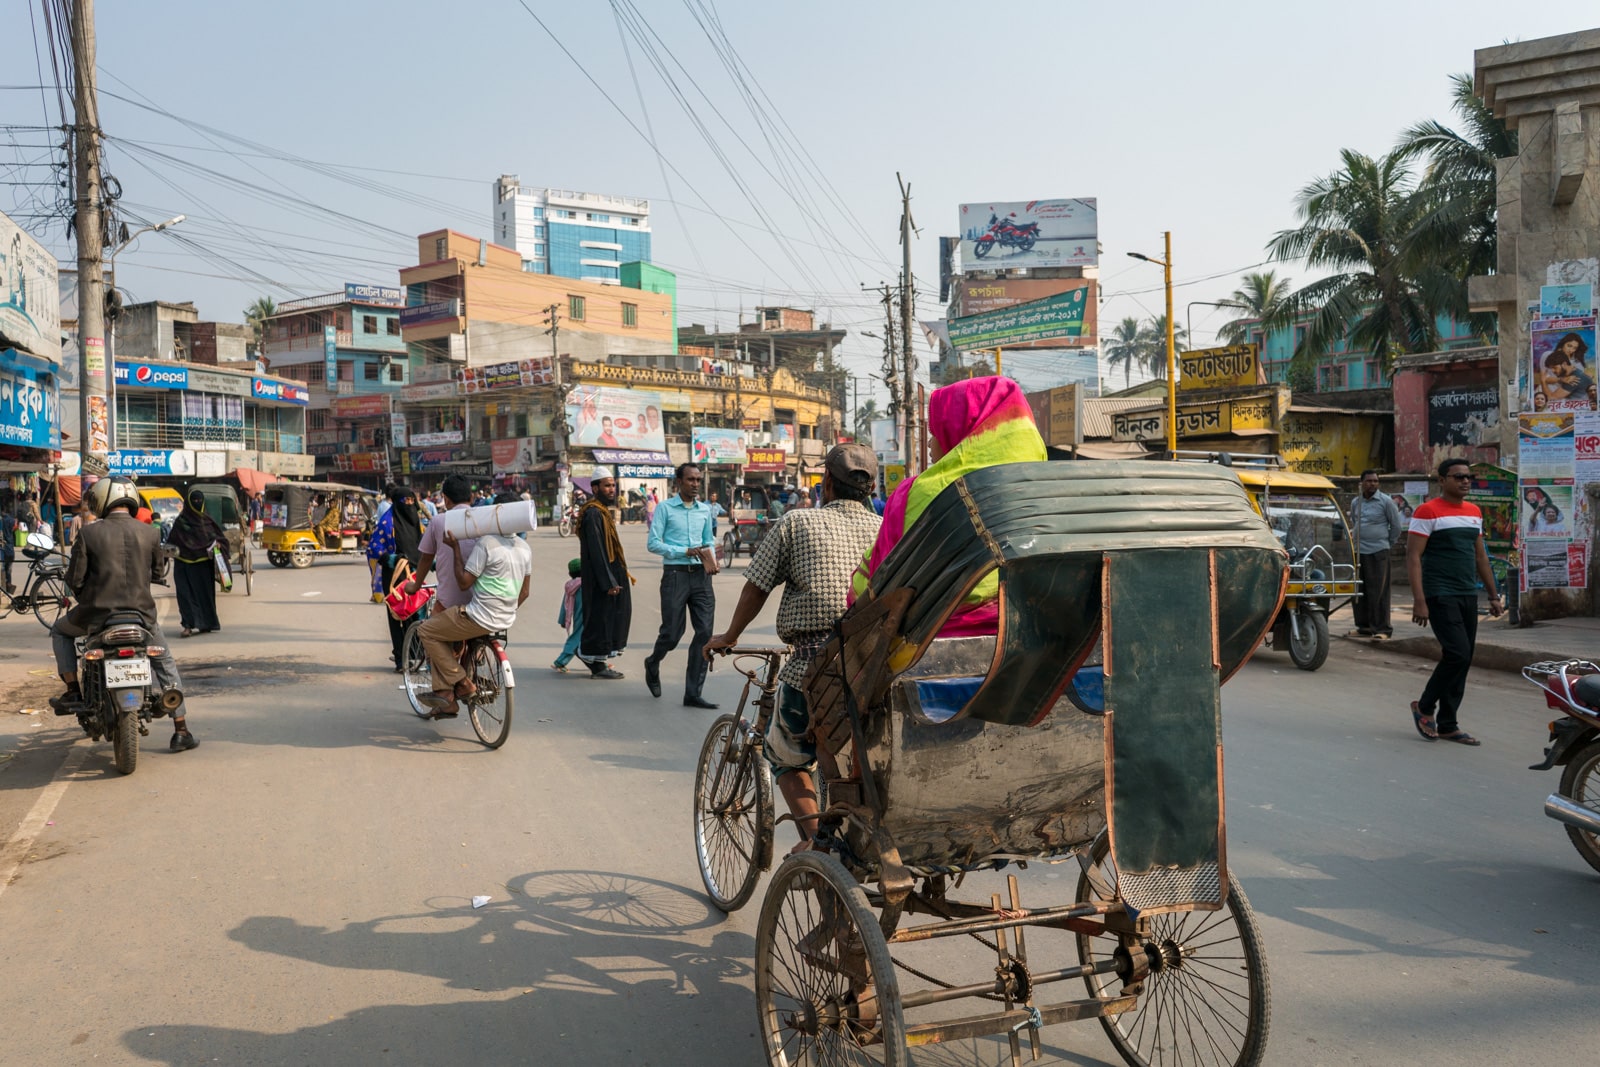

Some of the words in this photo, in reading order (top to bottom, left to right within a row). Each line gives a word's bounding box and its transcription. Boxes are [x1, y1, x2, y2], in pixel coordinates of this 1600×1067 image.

[968, 284, 1006, 298] রূপচাঁদা
[153, 372, 186, 384] pepsi
[16, 376, 43, 427] বুক
[1233, 403, 1252, 421] ঝিনুক
[1114, 416, 1162, 440] ঝিনুক
[88, 457, 106, 470] TO-LE
